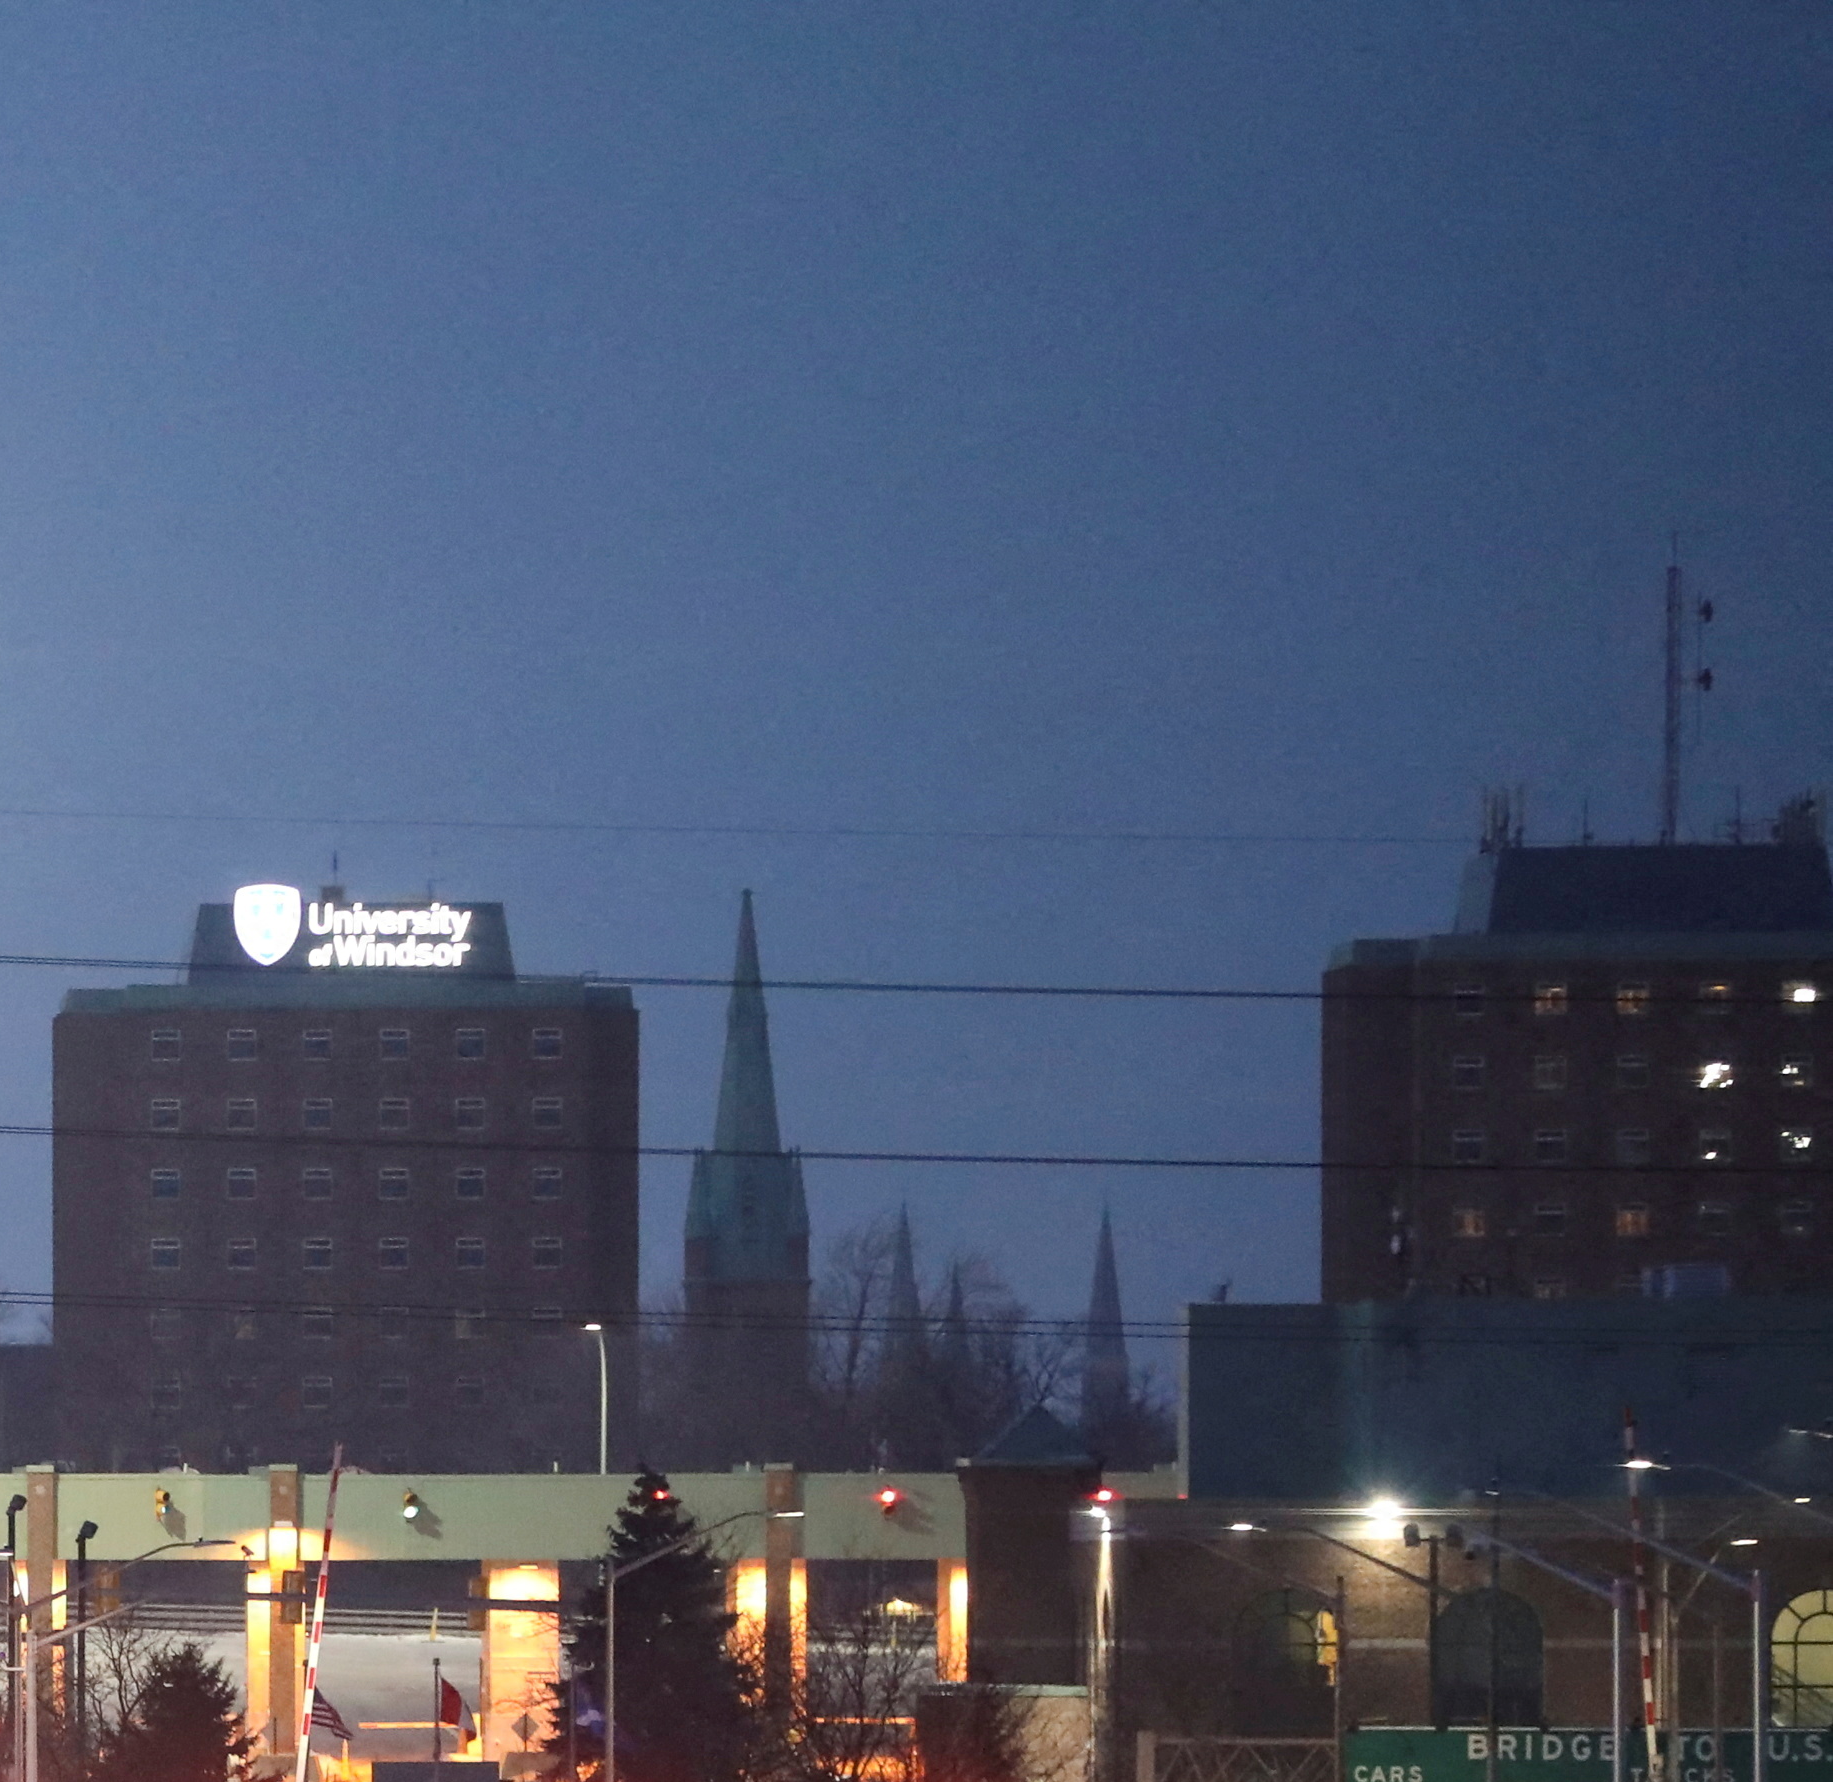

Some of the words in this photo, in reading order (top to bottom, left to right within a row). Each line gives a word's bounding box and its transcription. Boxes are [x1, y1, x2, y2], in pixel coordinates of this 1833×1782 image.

[308, 902, 472, 942] University
[308, 943, 333, 967] of
[333, 934, 472, 967] Windsor
[1467, 1733, 1615, 1761] BRIDGE
